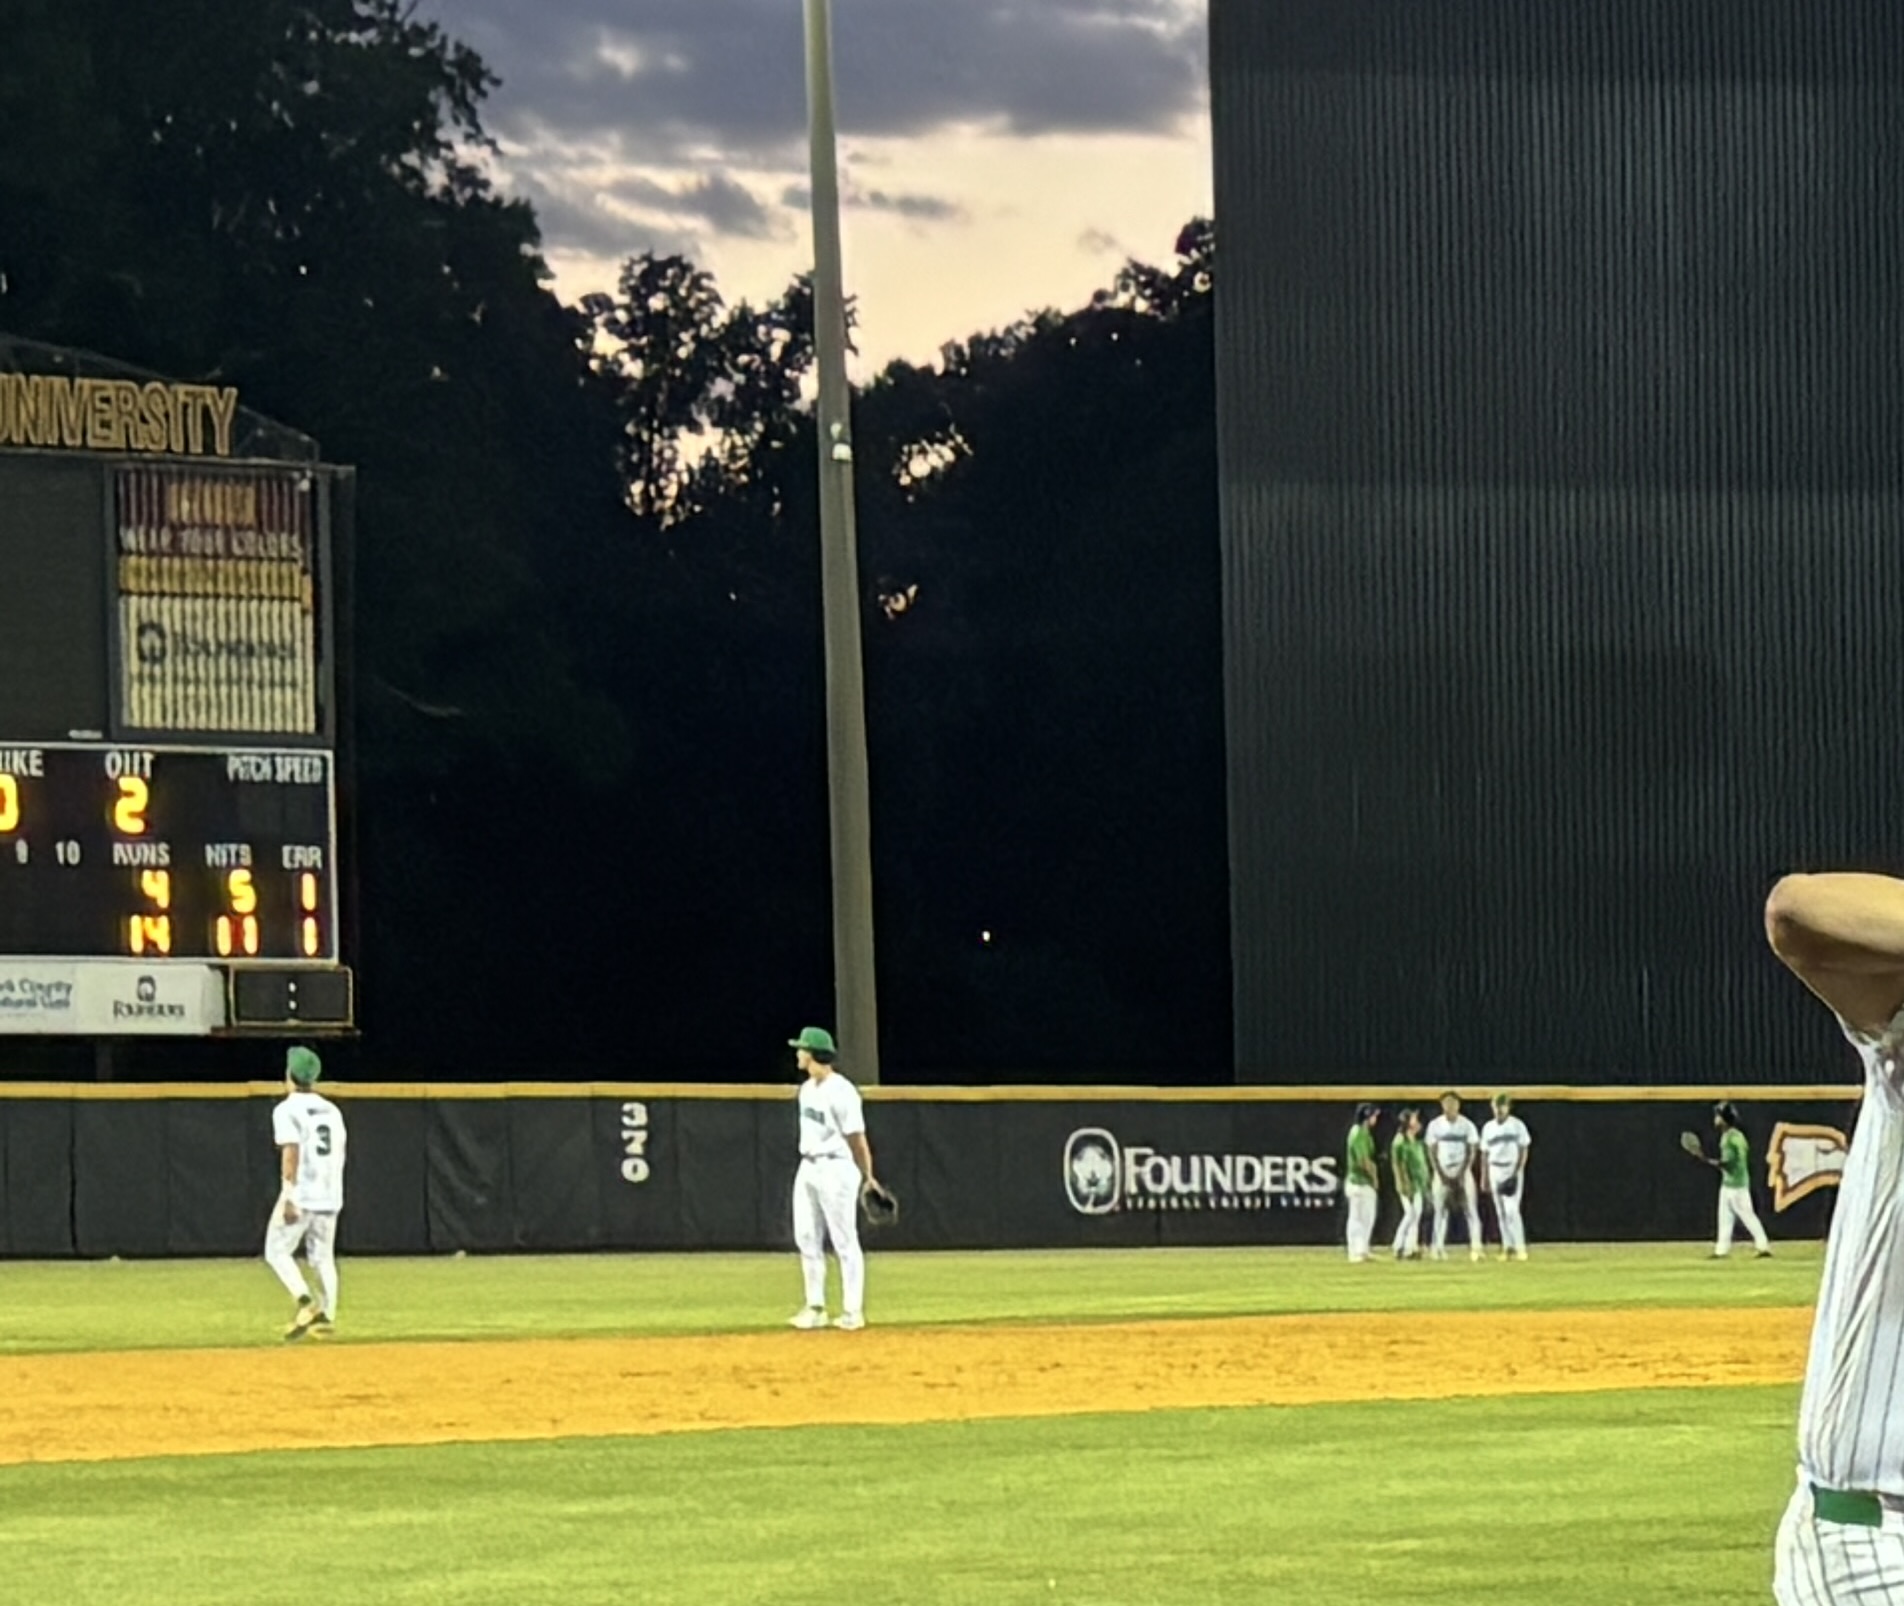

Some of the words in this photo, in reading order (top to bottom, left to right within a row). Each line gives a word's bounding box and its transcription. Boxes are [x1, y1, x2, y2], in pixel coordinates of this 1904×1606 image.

[105, 751, 155, 779] OUT
[115, 776, 148, 835] 2
[55, 840, 81, 866] 10
[112, 842, 171, 866] RUNS
[142, 869, 171, 910] 4
[301, 873, 317, 912] 1
[129, 915, 171, 954] 14
[216, 915, 259, 956] 11
[303, 916, 319, 956] 1
[316, 1124, 332, 1157] 3
[1123, 1147, 1338, 1195] FOUNDERS
